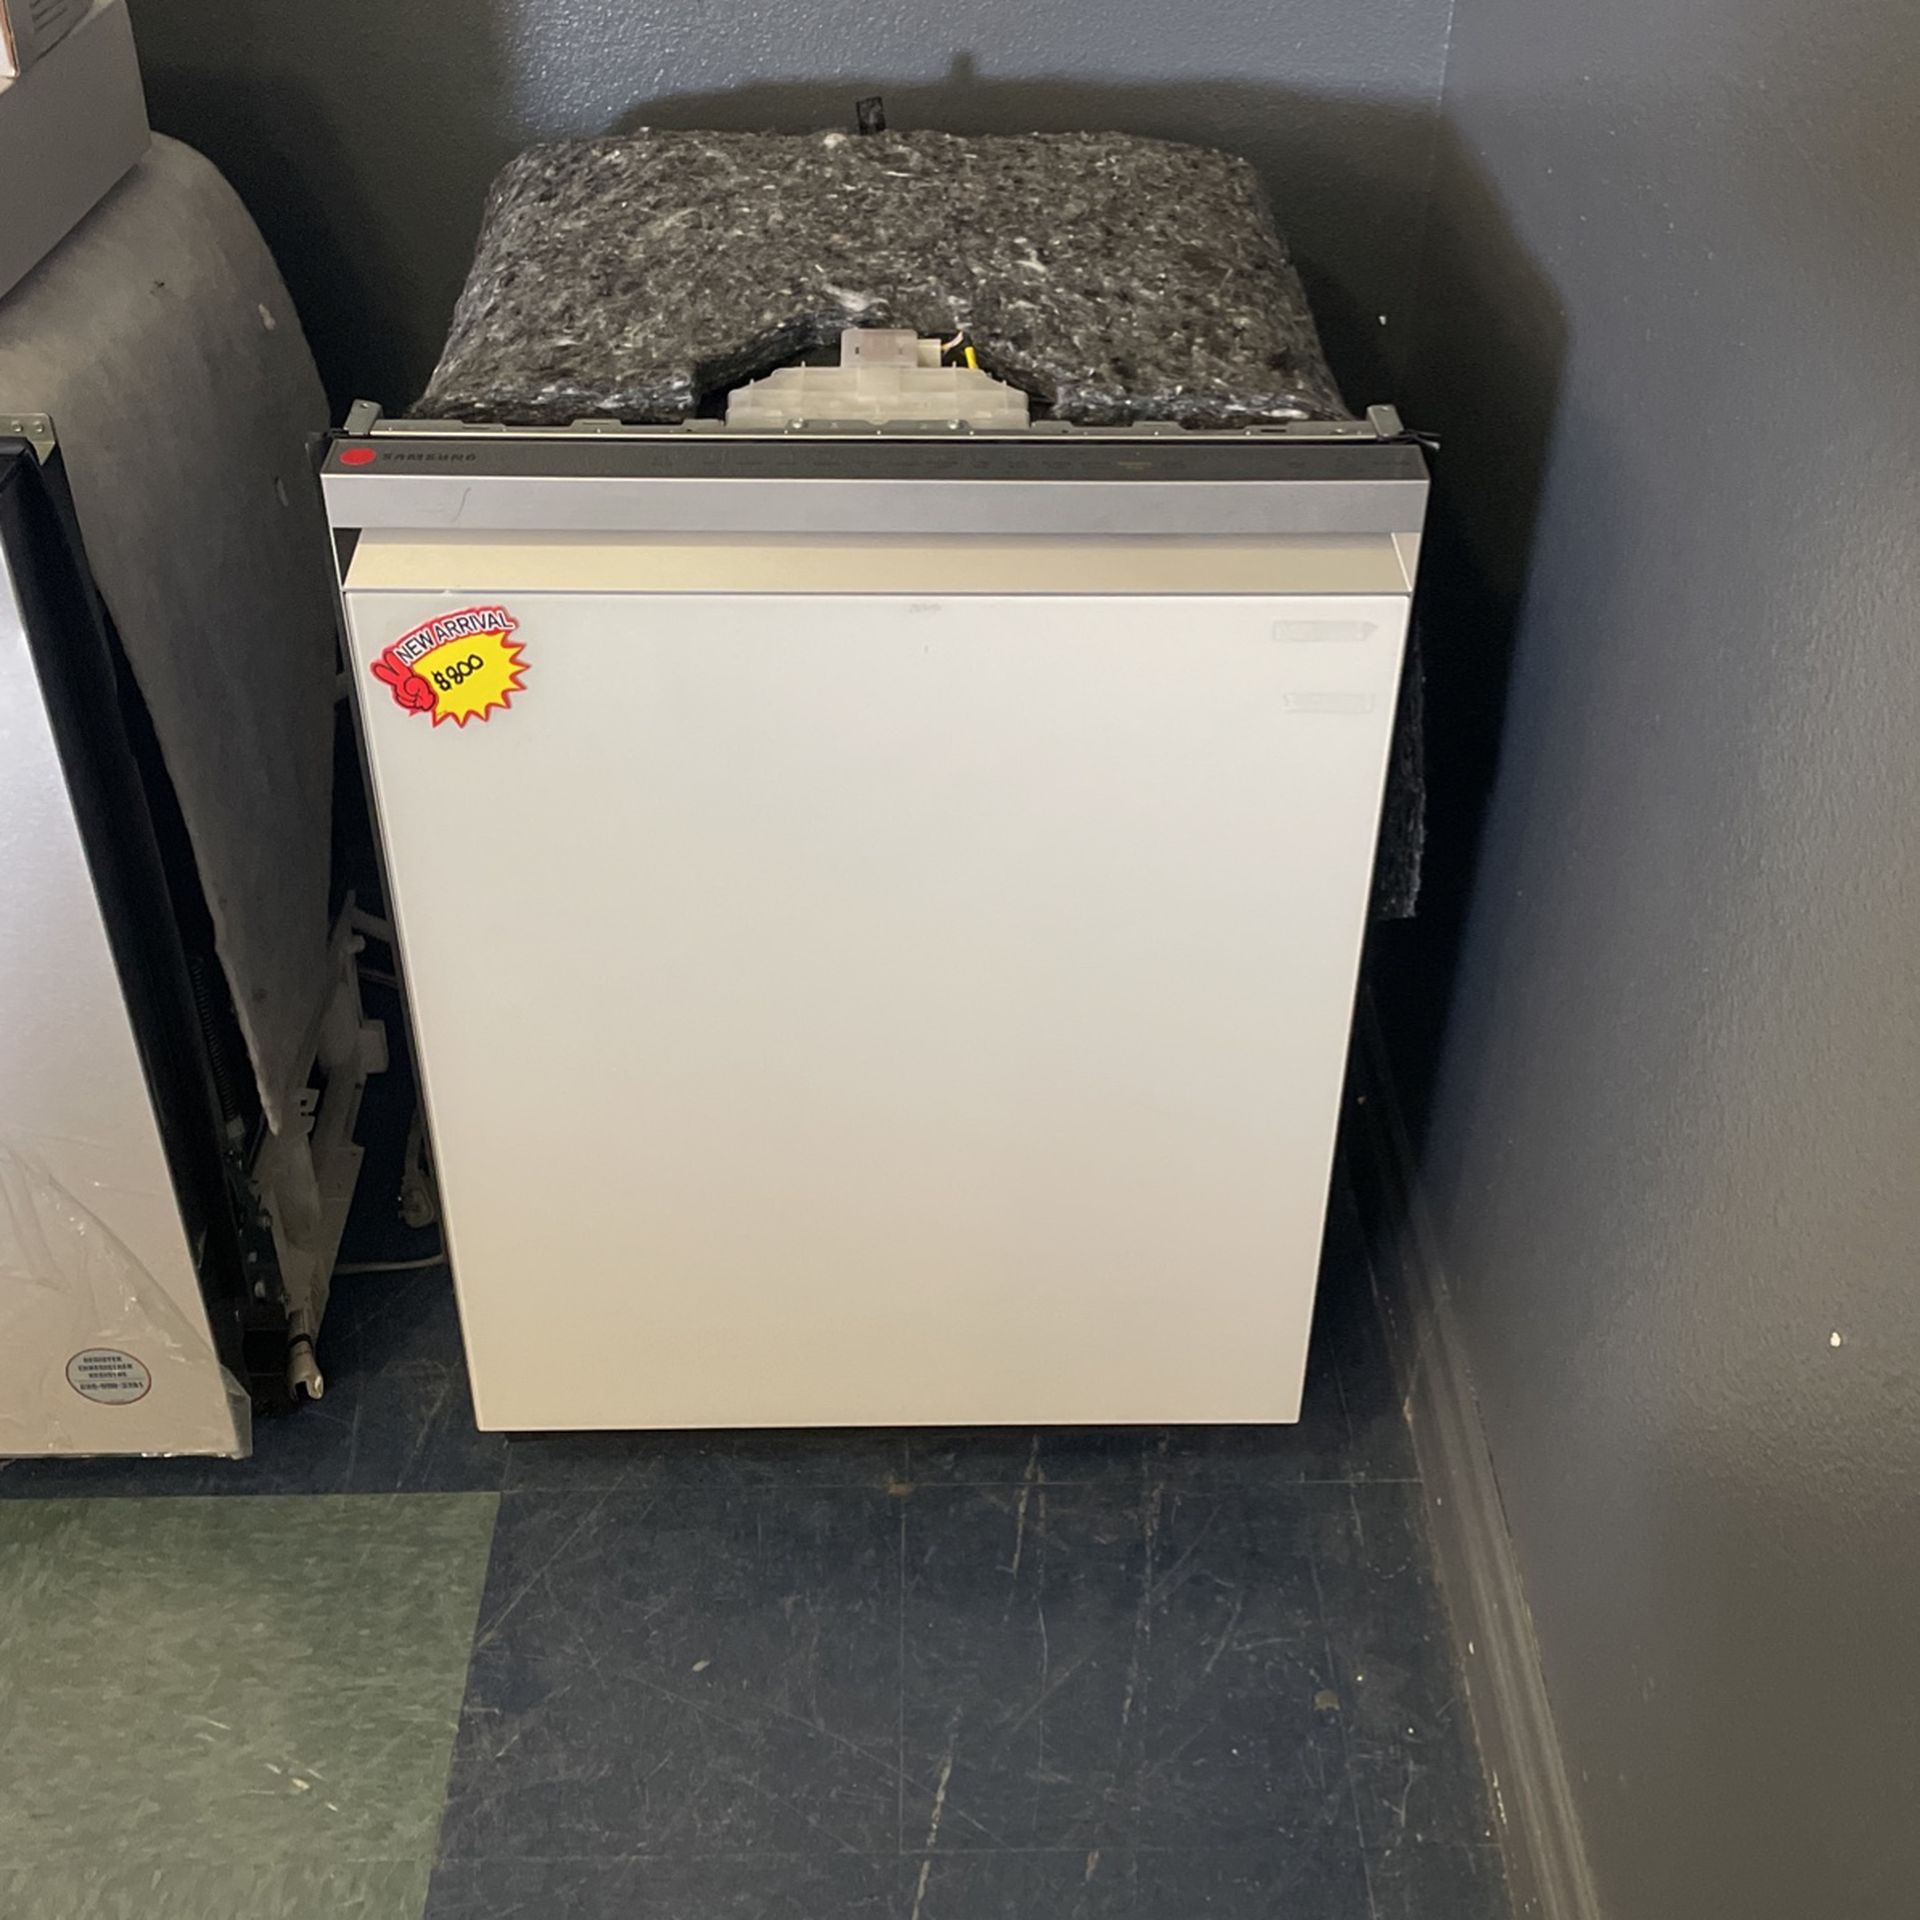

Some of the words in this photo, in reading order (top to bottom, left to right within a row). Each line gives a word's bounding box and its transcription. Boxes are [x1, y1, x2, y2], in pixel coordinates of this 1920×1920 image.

[383, 452, 477, 462] SAMSUNG
[395, 631, 434, 663] NEW
[434, 612, 513, 642] ARRIVAL
[431, 653, 484, 692] $800
